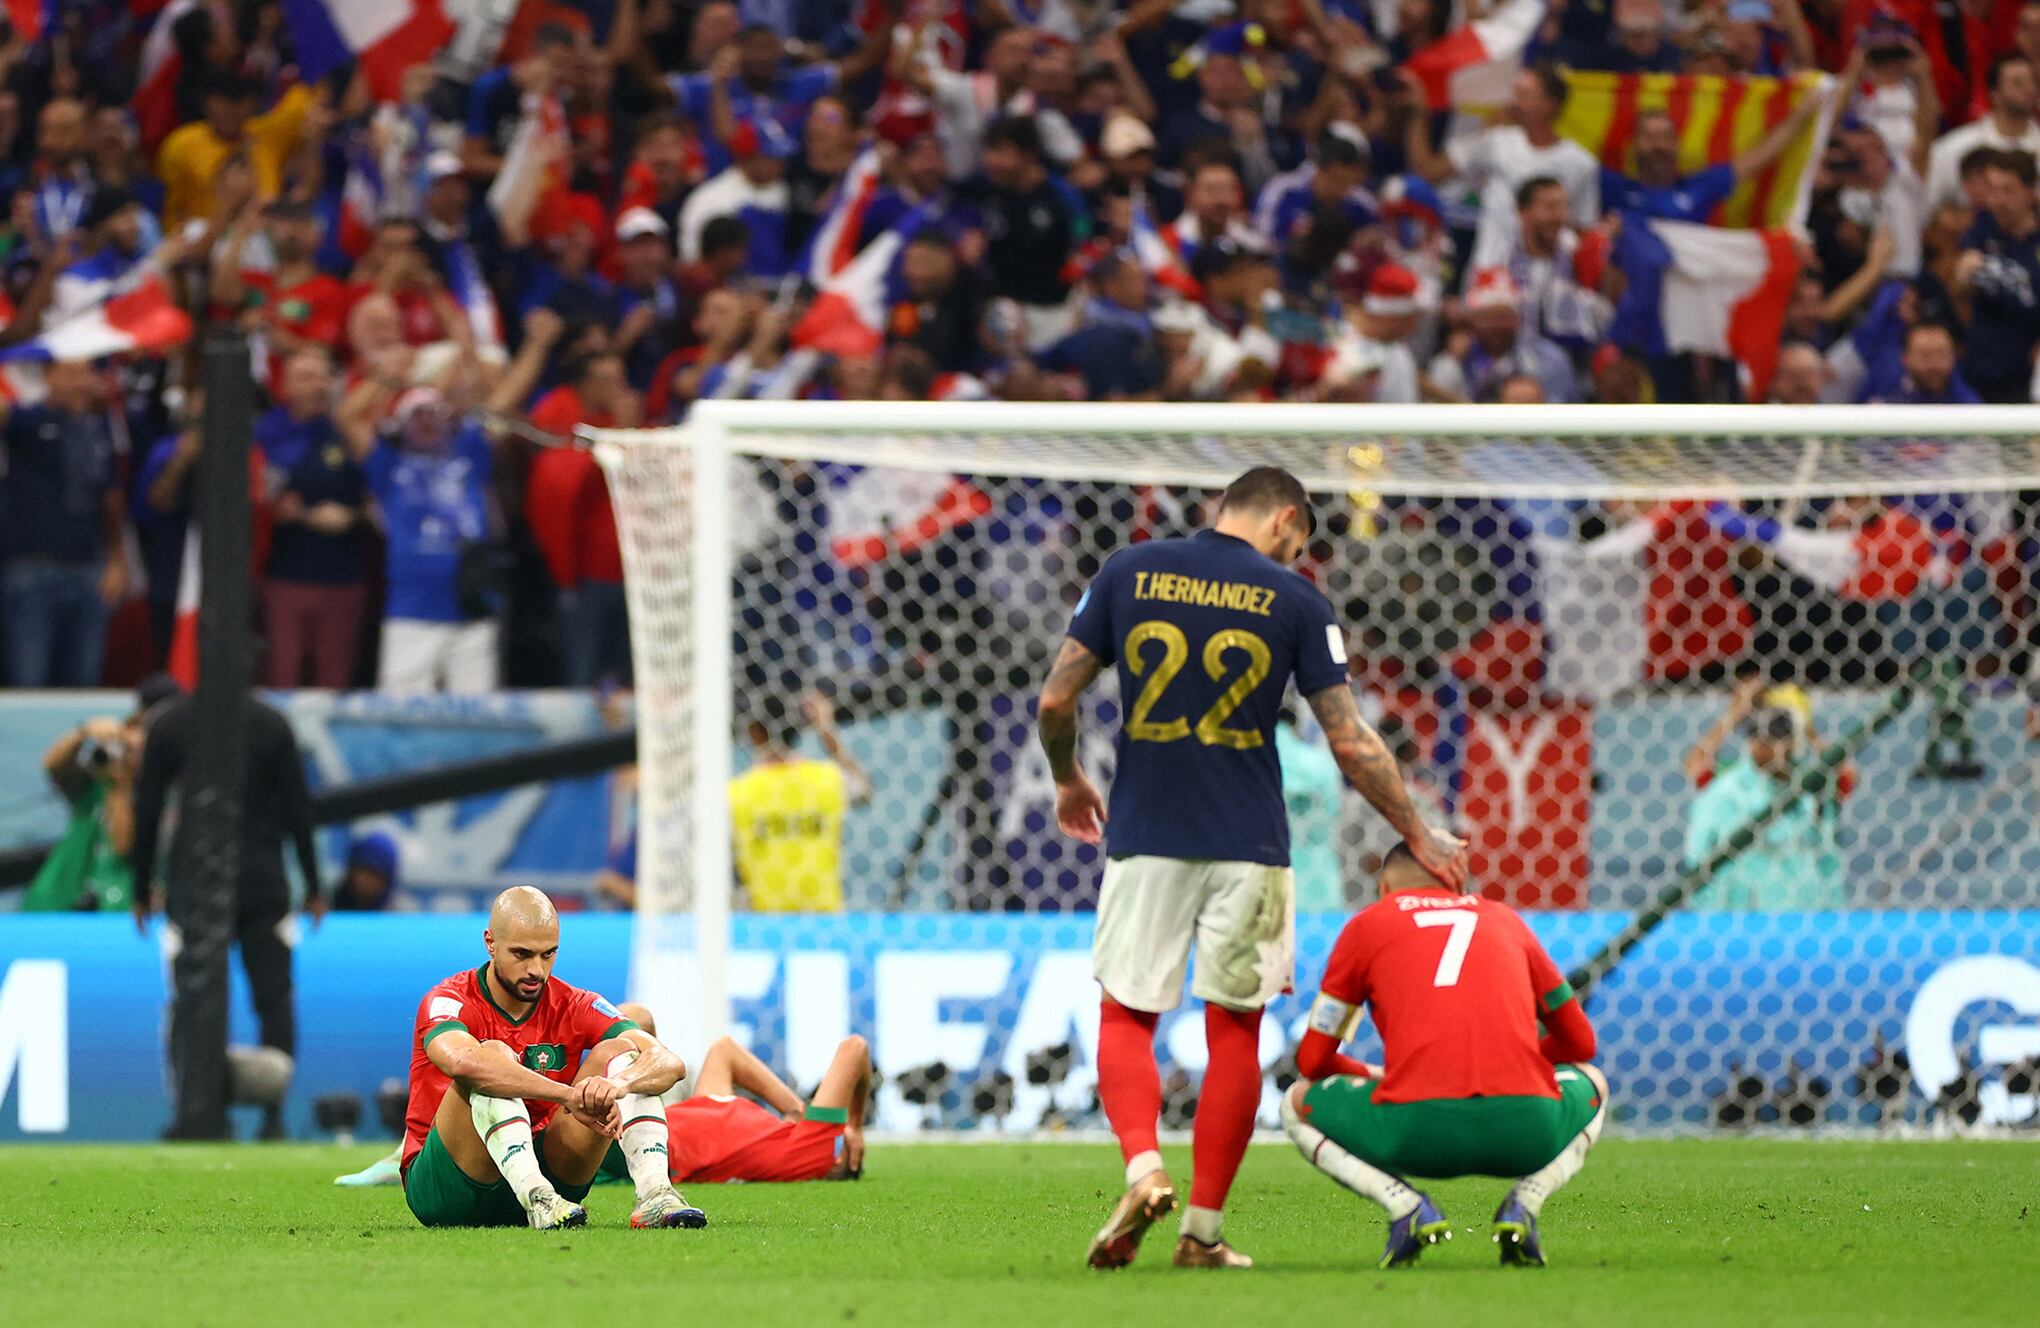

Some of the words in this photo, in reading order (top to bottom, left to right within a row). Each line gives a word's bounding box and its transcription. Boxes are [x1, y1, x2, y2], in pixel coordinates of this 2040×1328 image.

[1134, 570, 1277, 617] T.HERNANDEZ
[1124, 619, 1273, 750] 22
[1412, 908, 1479, 988] 7
